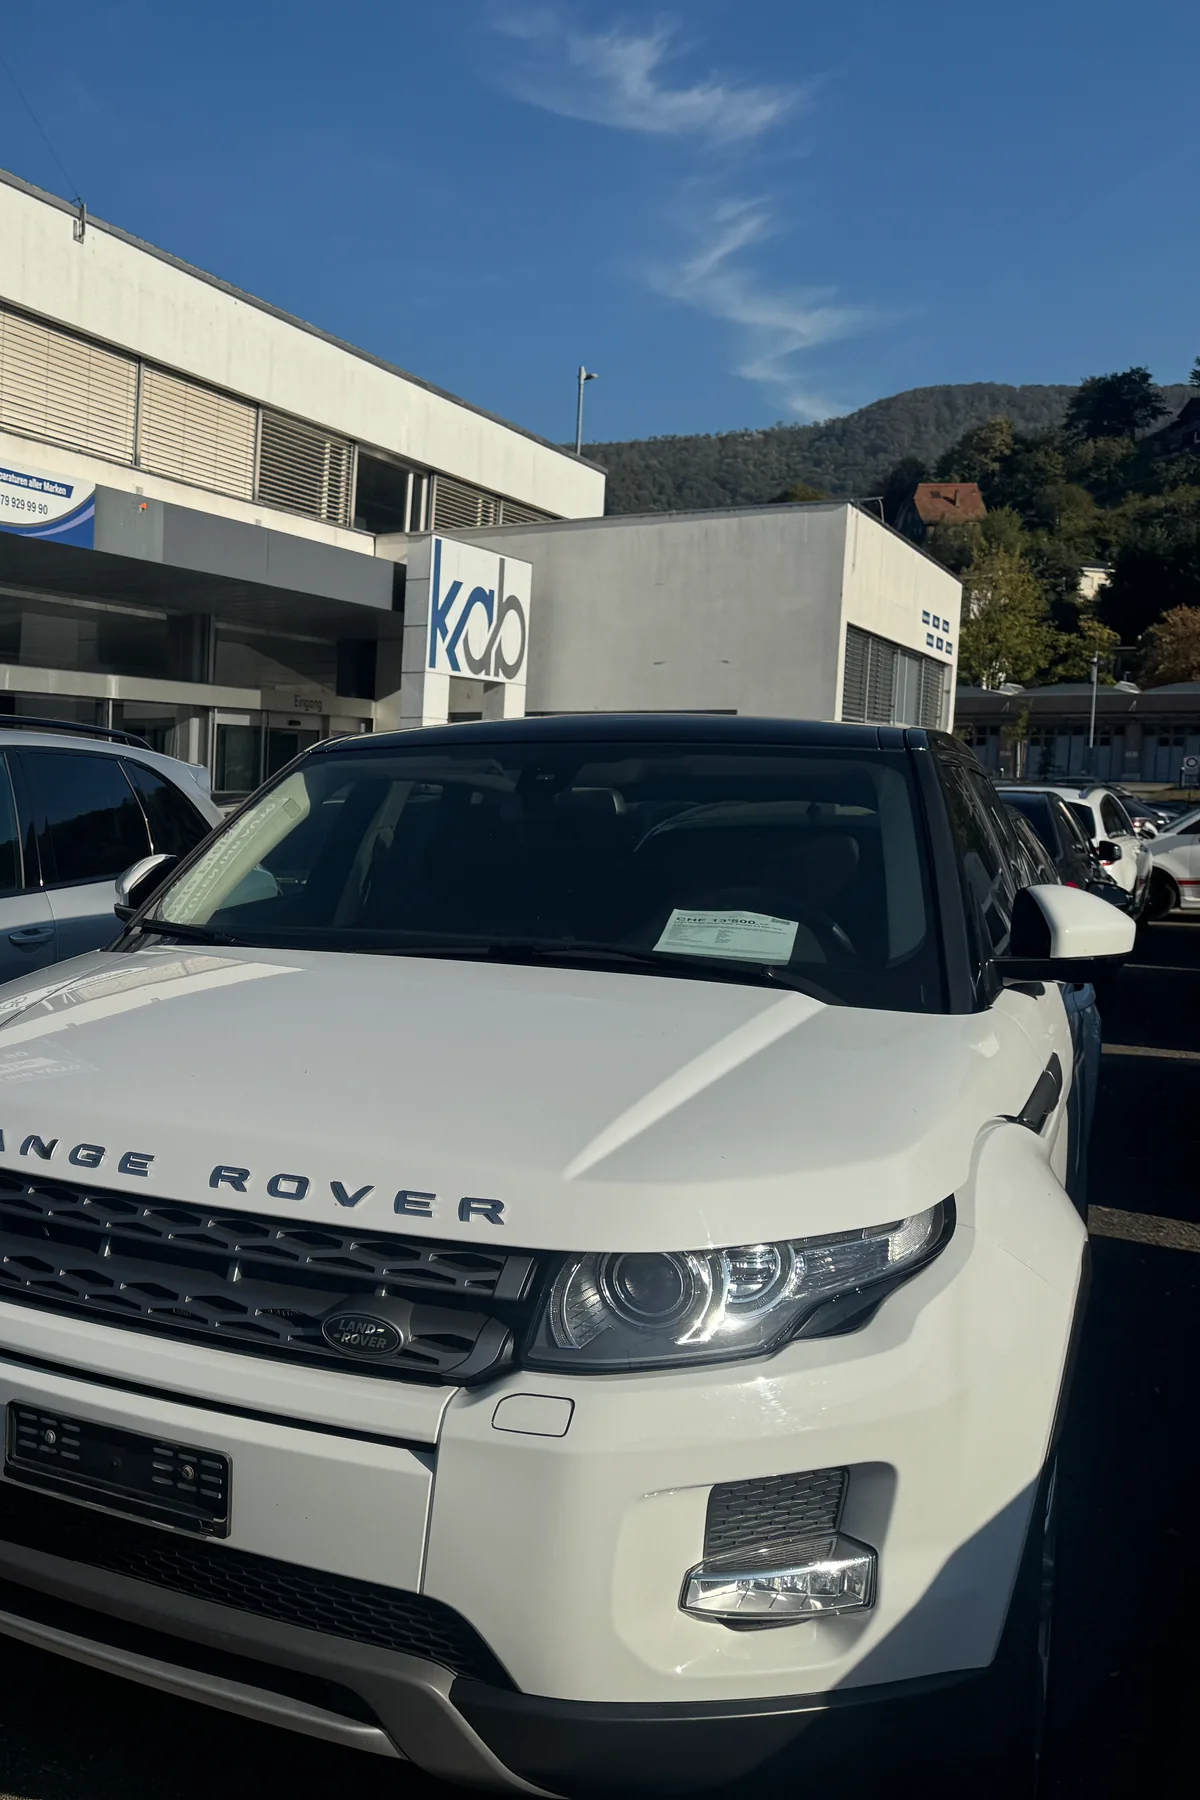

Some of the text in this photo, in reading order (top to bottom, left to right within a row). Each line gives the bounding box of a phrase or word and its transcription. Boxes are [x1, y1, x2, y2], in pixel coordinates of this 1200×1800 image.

[29, 479, 42, 490] aller
[43, 481, 67, 496] Marken
[11, 497, 25, 510] 929
[26, 502, 37, 513] 99
[38, 504, 49, 515] 90
[428, 538, 527, 680] kab
[294, 694, 323, 713] Eingang
[208, 1164, 506, 1226] ROVER
[338, 1320, 376, 1335] LAND
[341, 1331, 388, 1349] ROVER
